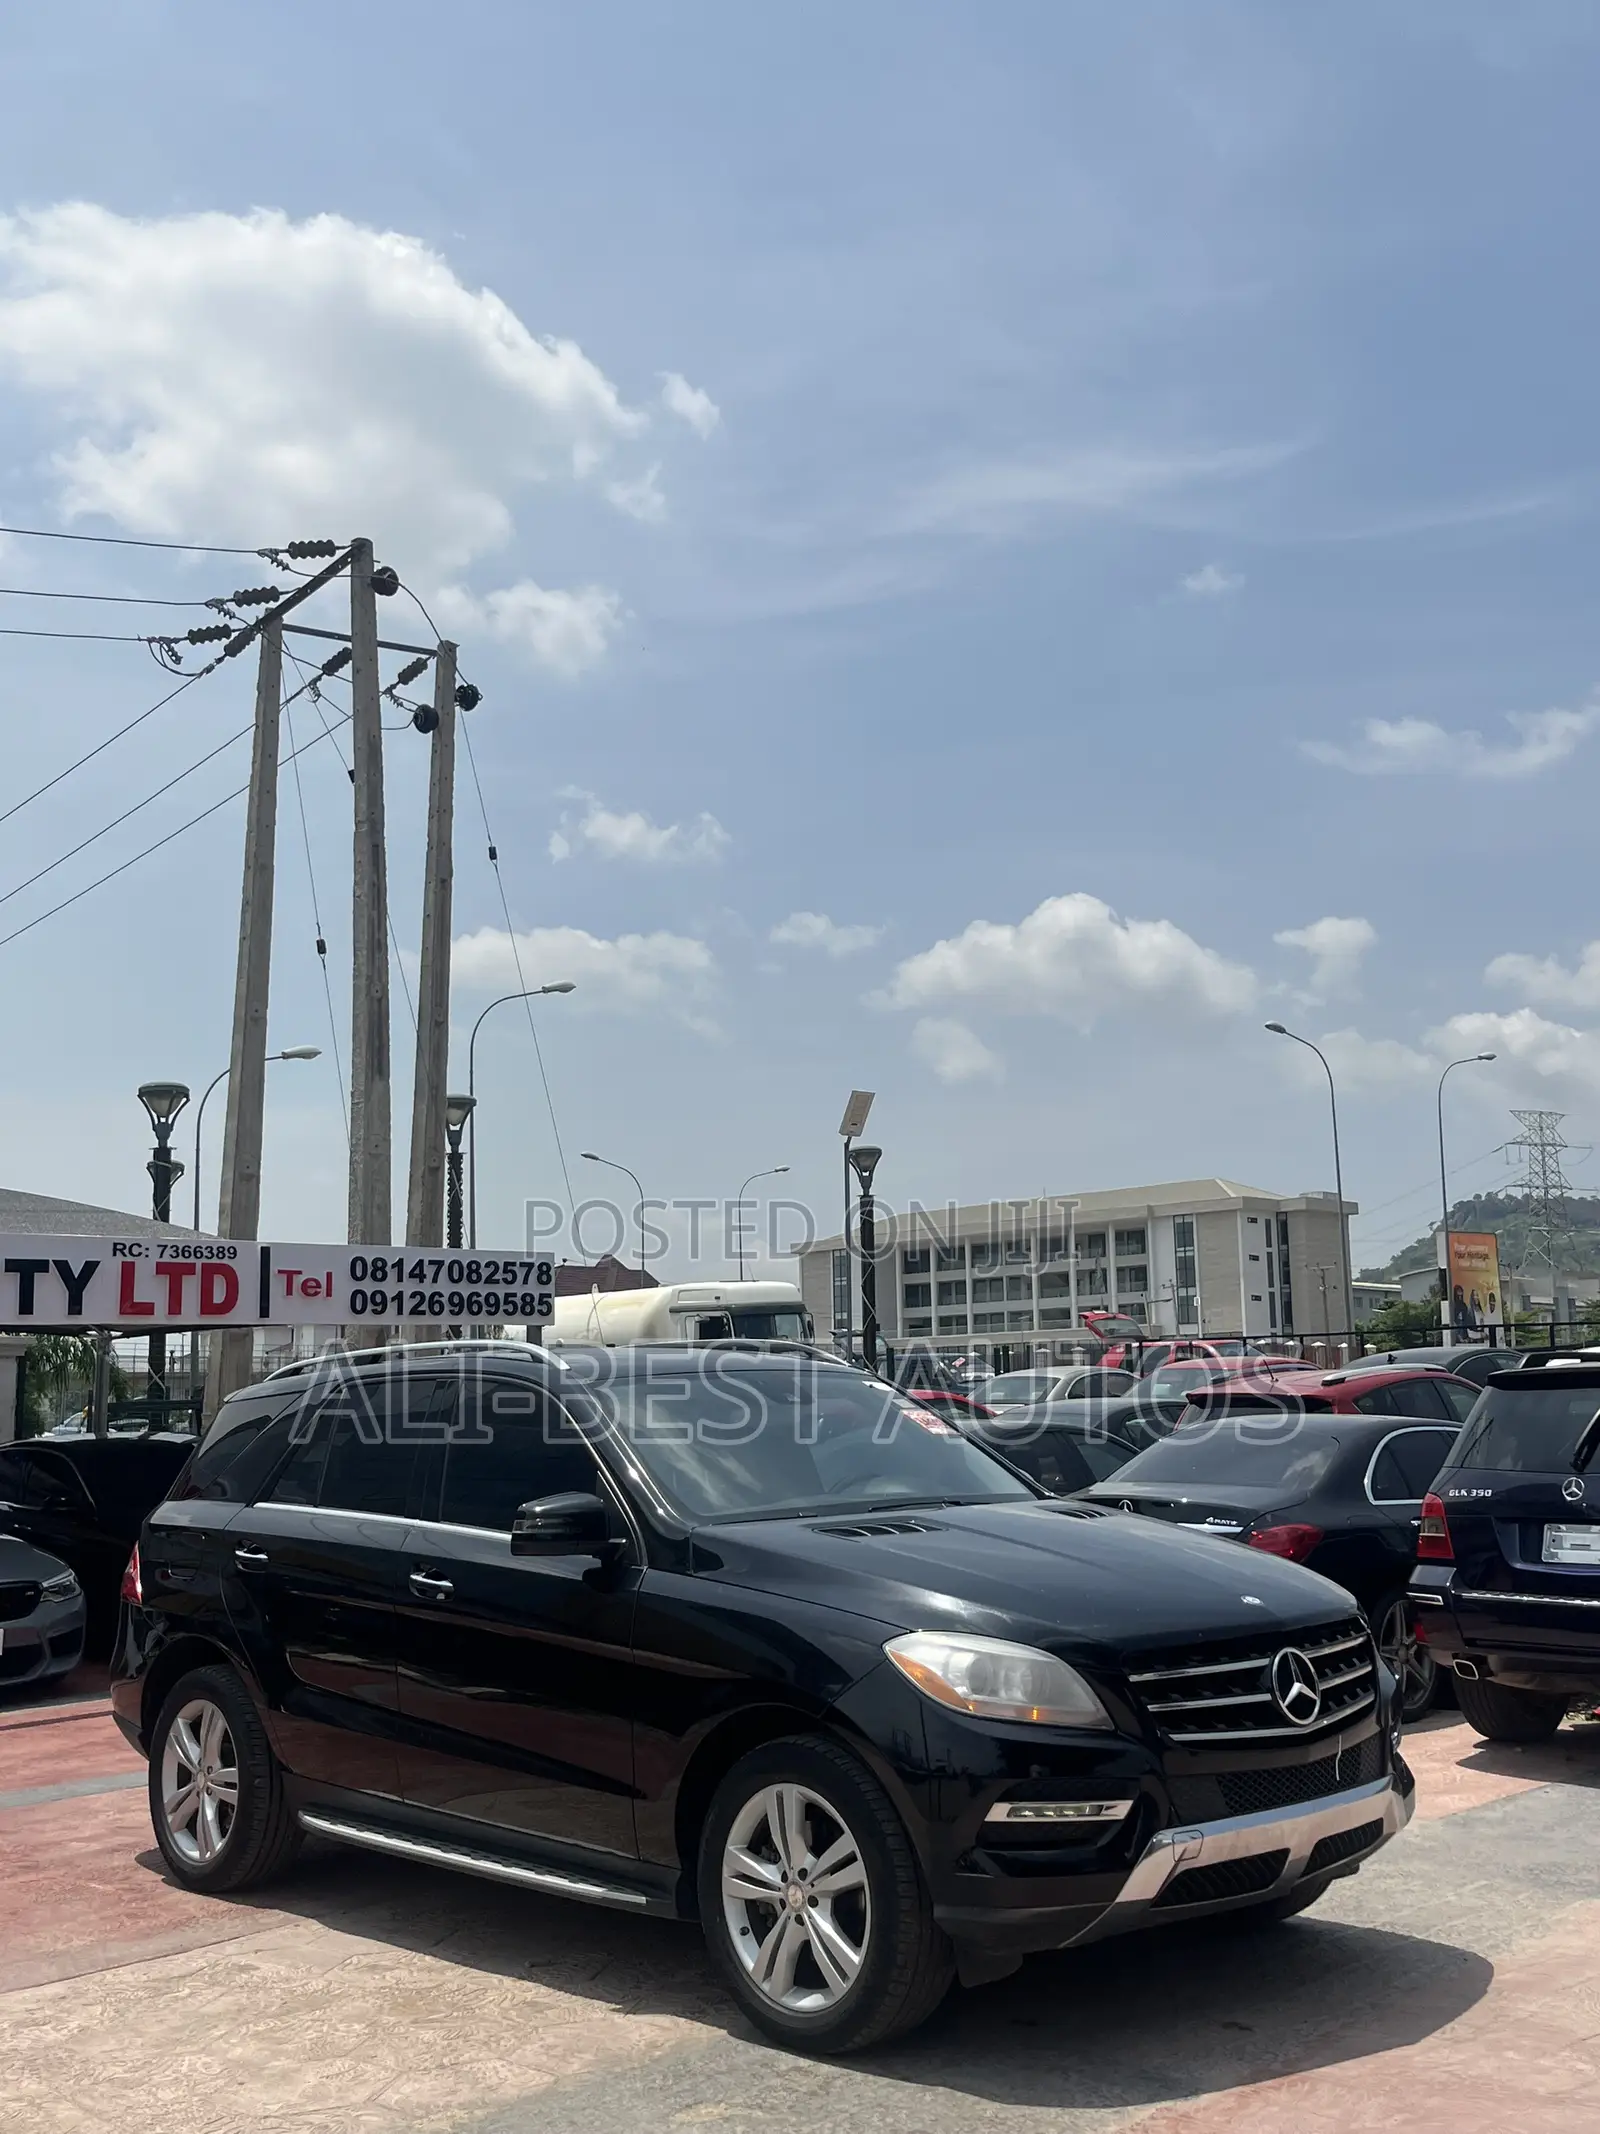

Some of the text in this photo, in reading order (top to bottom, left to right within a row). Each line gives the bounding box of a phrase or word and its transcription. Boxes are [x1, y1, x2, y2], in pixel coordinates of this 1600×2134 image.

[112, 1242, 238, 1260] RC: 7366389
[277, 1269, 333, 1298] Tel
[350, 1256, 553, 1286] 08147082578
[4, 1258, 240, 1316] TY LTD
[350, 1289, 553, 1317] 09126969585
[1448, 1488, 1492, 1497] GLK 350
